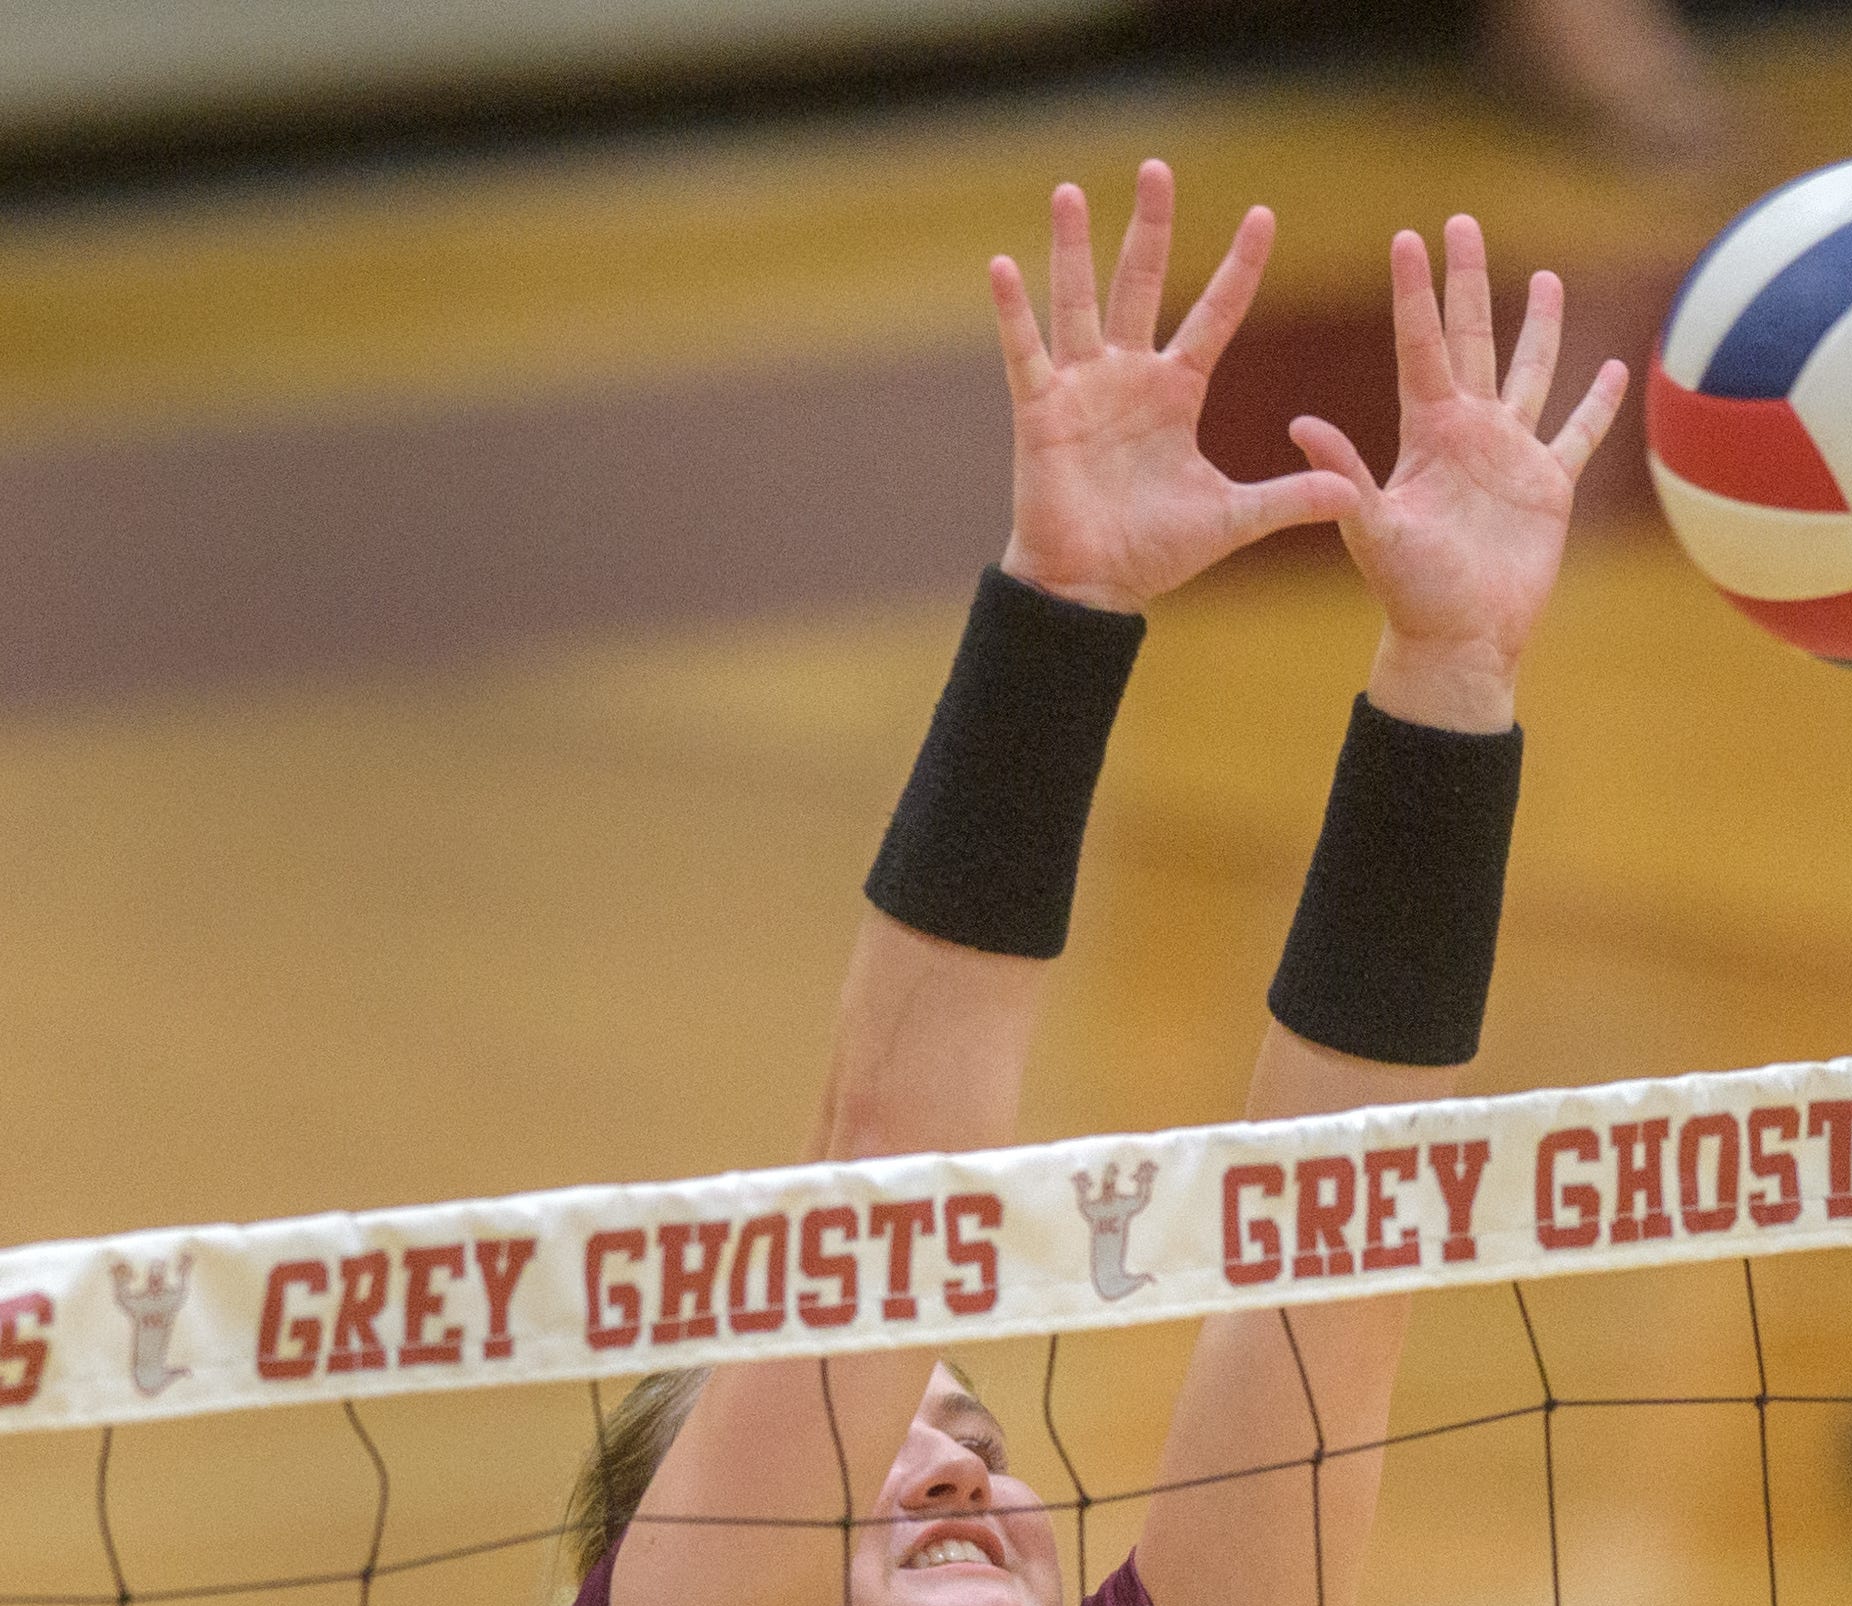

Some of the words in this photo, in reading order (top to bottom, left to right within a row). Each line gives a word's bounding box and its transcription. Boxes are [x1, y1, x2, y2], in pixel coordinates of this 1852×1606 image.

[257, 1237, 538, 1381] GREY
[584, 1192, 1003, 1351] GHOSTS
[1222, 1139, 1490, 1287] GREY
